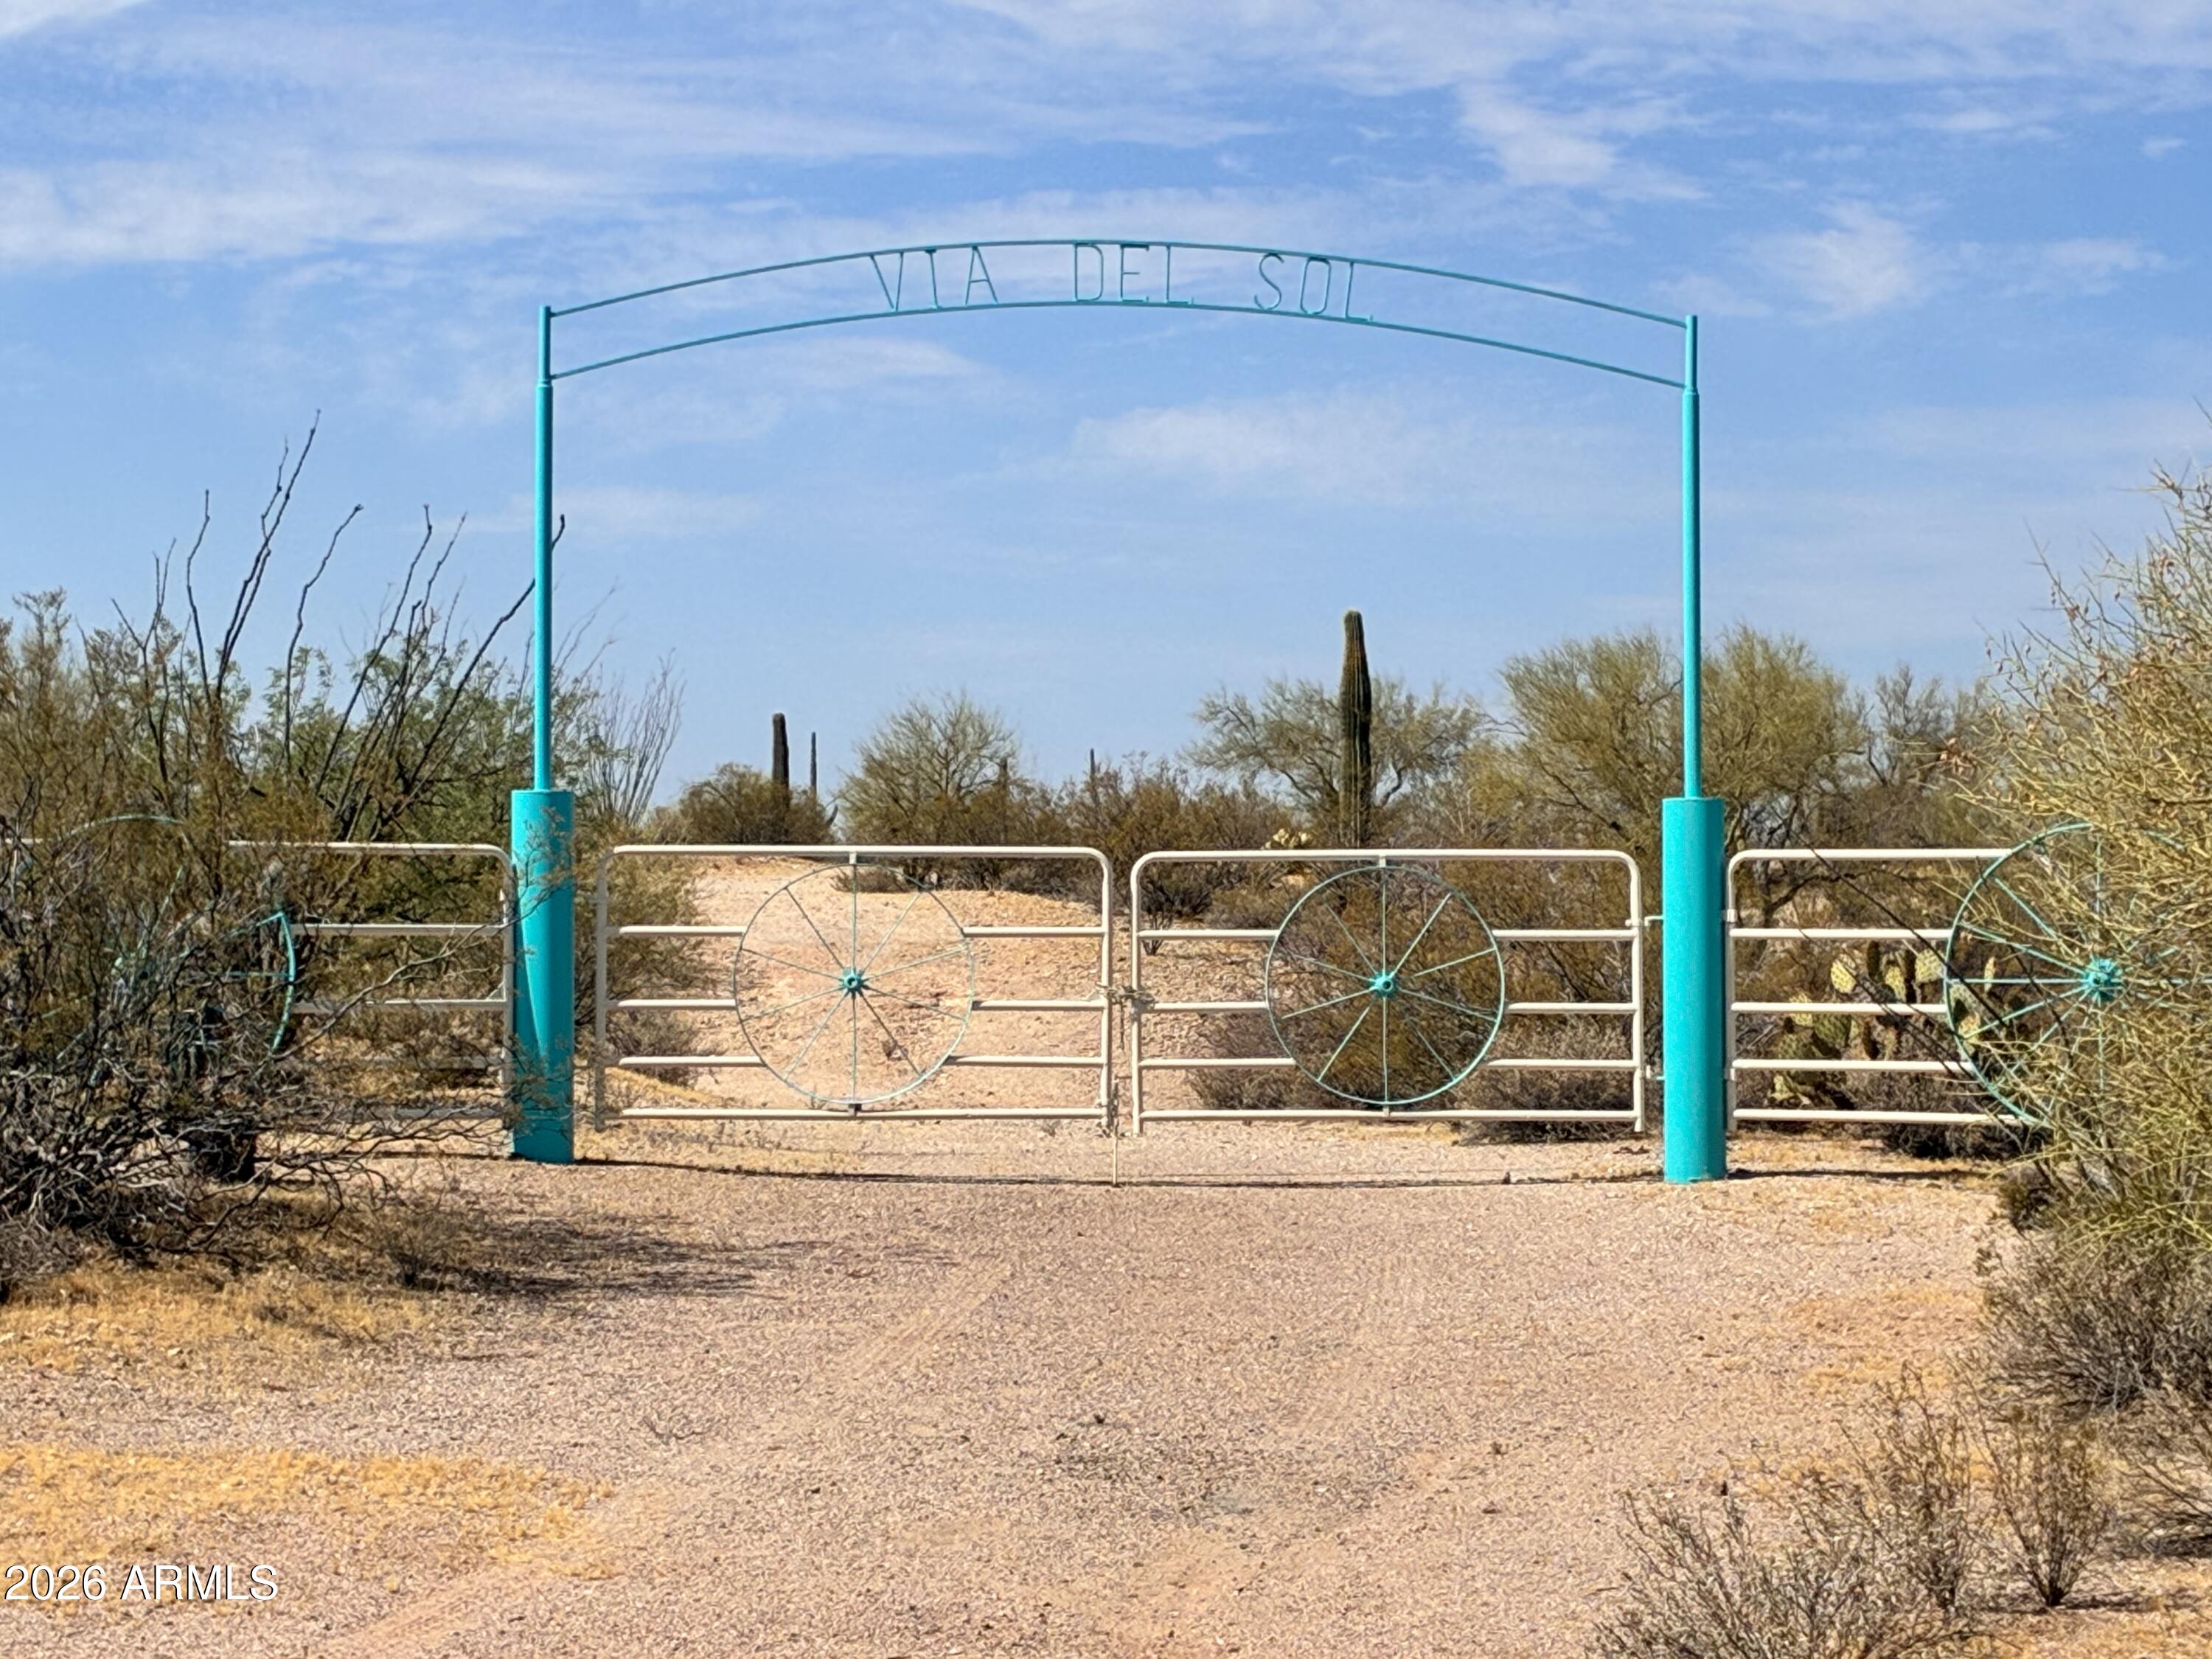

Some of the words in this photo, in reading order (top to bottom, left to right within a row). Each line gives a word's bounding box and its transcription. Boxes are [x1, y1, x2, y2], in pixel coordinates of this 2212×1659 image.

[870, 246, 998, 311] VIA
[1074, 243, 1194, 305] DEL
[1254, 252, 1374, 321] SOL
